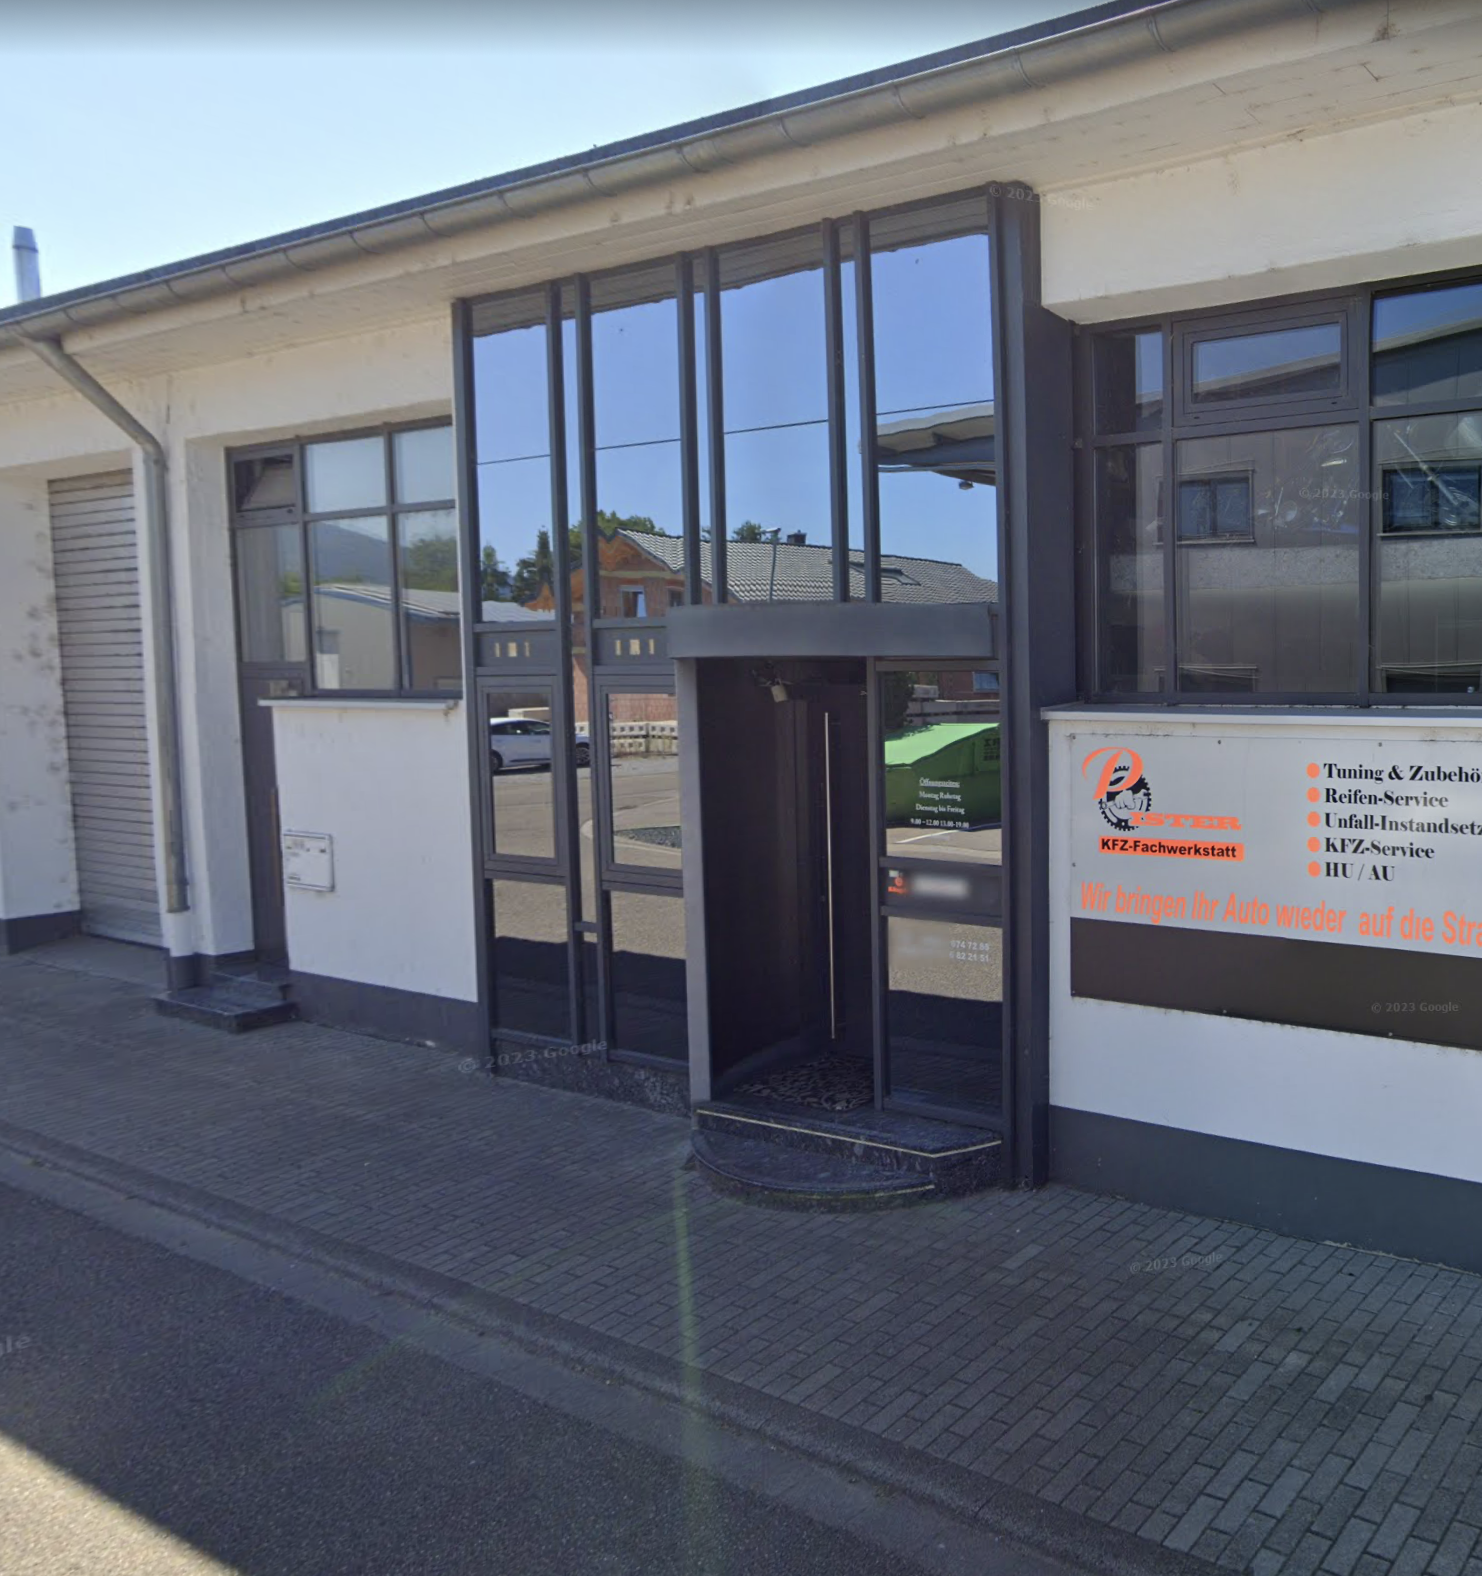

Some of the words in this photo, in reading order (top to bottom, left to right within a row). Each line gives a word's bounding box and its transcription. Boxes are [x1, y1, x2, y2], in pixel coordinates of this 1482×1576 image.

[1323, 762, 1384, 785] Tuning
[1388, 765, 1404, 781] &
[1324, 787, 1449, 808] Reifen-Service
[1101, 838, 1237, 858] KFZ-Fachwerkstatt
[1324, 837, 1435, 859] KFZ-Service
[1324, 861, 1354, 879] HU
[1368, 864, 1395, 882] AU
[1081, 881, 1111, 913] Wir
[1115, 884, 1187, 925] bringen
[1191, 889, 1219, 922] Ihr
[1222, 892, 1270, 926] Auto
[1276, 900, 1347, 934] wieder
[1358, 906, 1395, 938] auf
[1400, 908, 1435, 942] die
